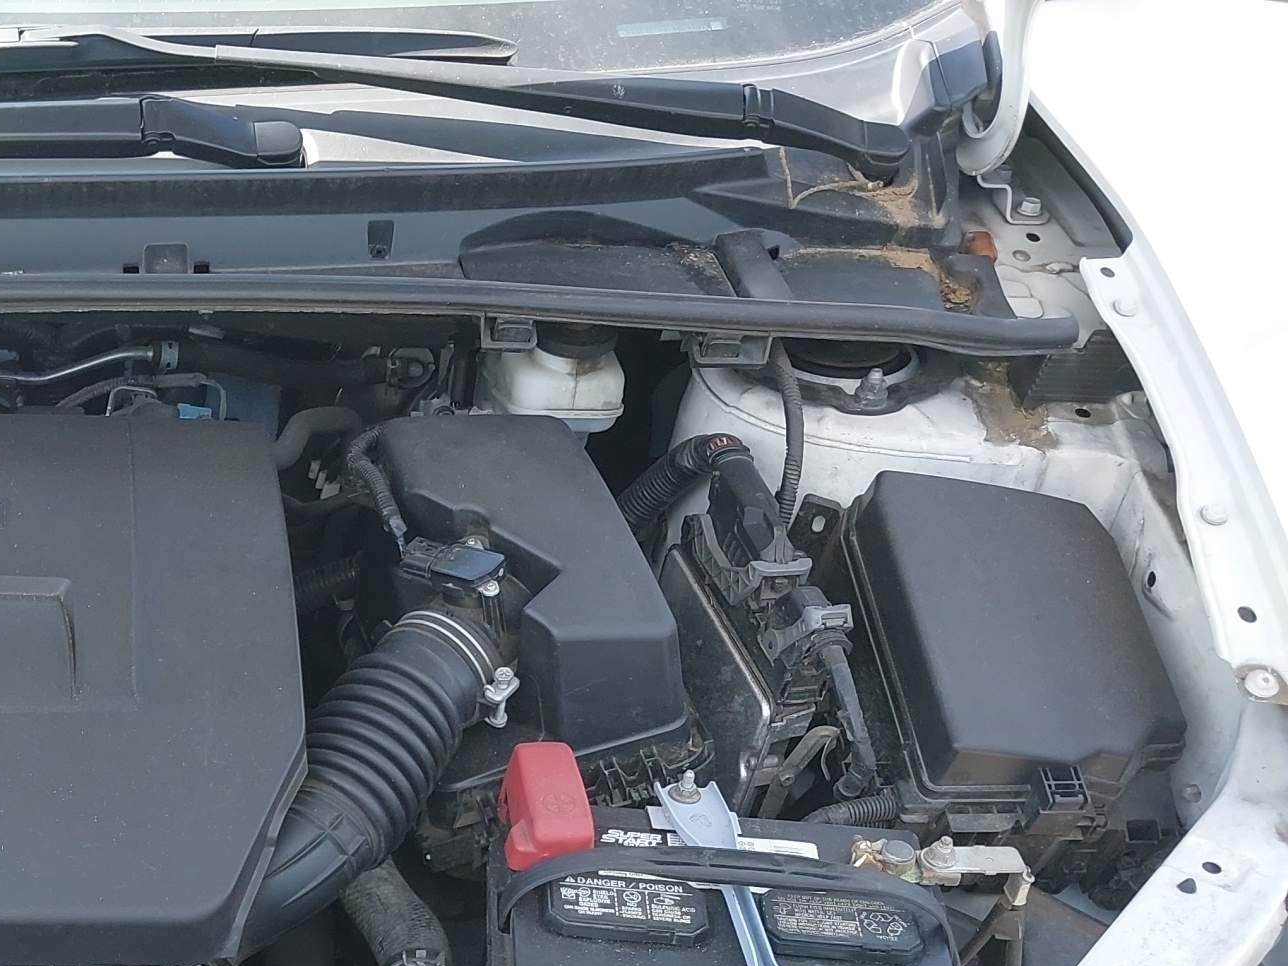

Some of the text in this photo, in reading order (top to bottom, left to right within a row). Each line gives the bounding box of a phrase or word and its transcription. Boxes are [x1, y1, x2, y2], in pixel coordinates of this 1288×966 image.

[607, 828, 663, 844] SUPER
[577, 875, 626, 888] DANGER
[638, 882, 683, 894] POISON
